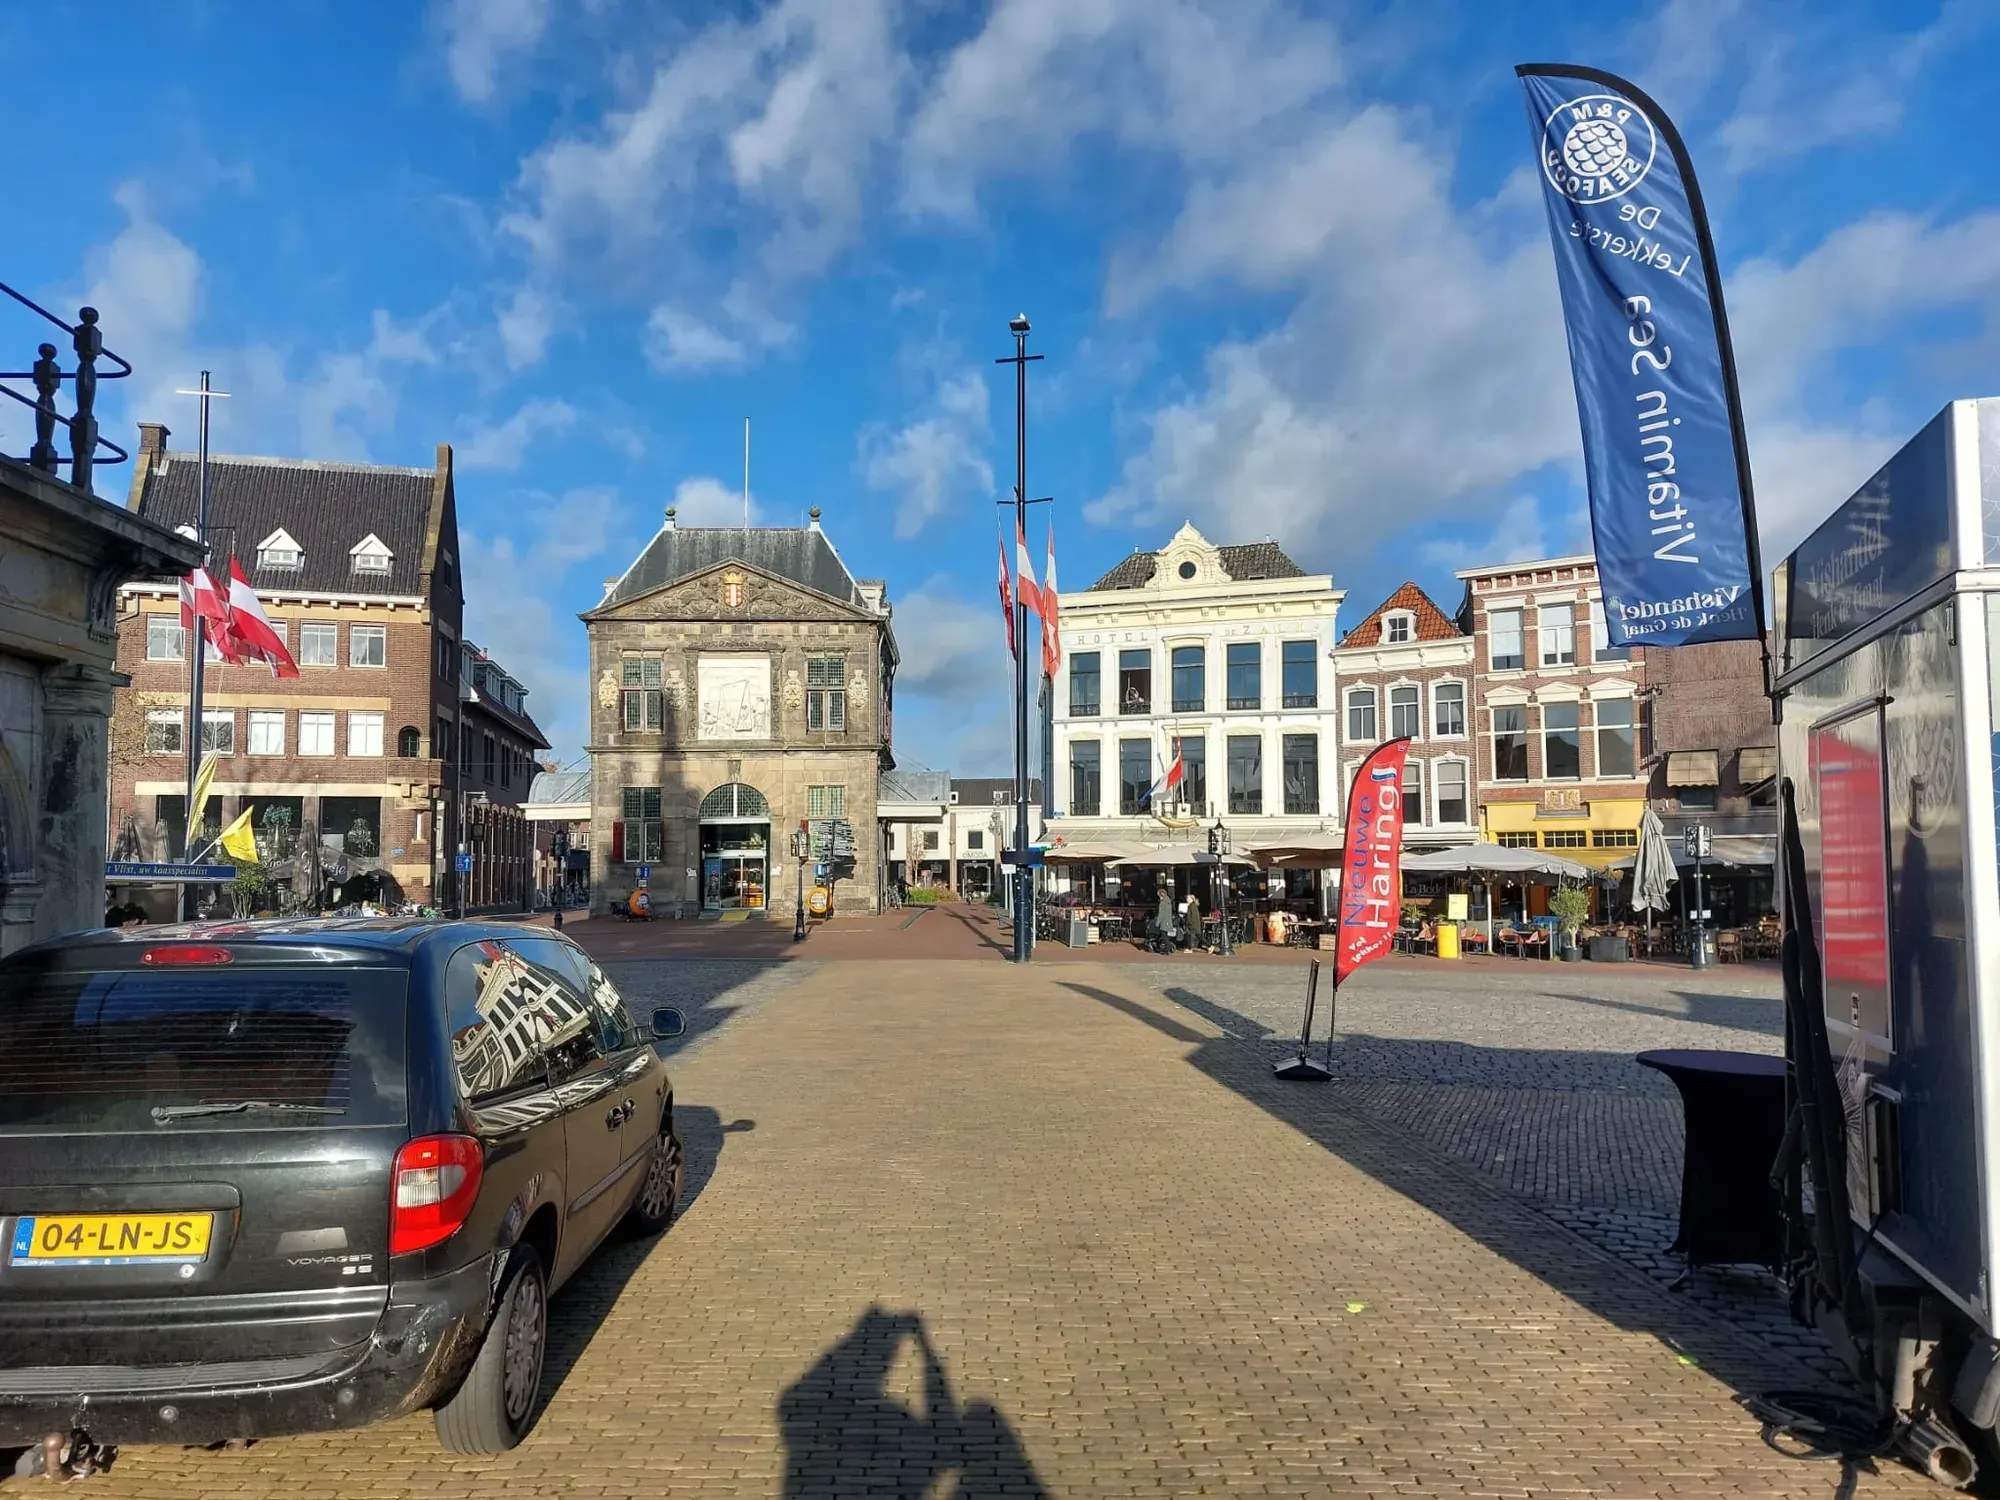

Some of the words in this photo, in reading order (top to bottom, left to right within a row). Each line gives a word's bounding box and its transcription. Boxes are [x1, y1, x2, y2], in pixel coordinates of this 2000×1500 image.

[1077, 631, 1149, 646] HOTEL
[1343, 796, 1373, 927] Nieuwe
[1365, 783, 1401, 928] Haring
[15, 1241, 28, 1251] NL
[42, 1221, 193, 1251] 04-LN-JS
[287, 1253, 373, 1265] VOYAGER
